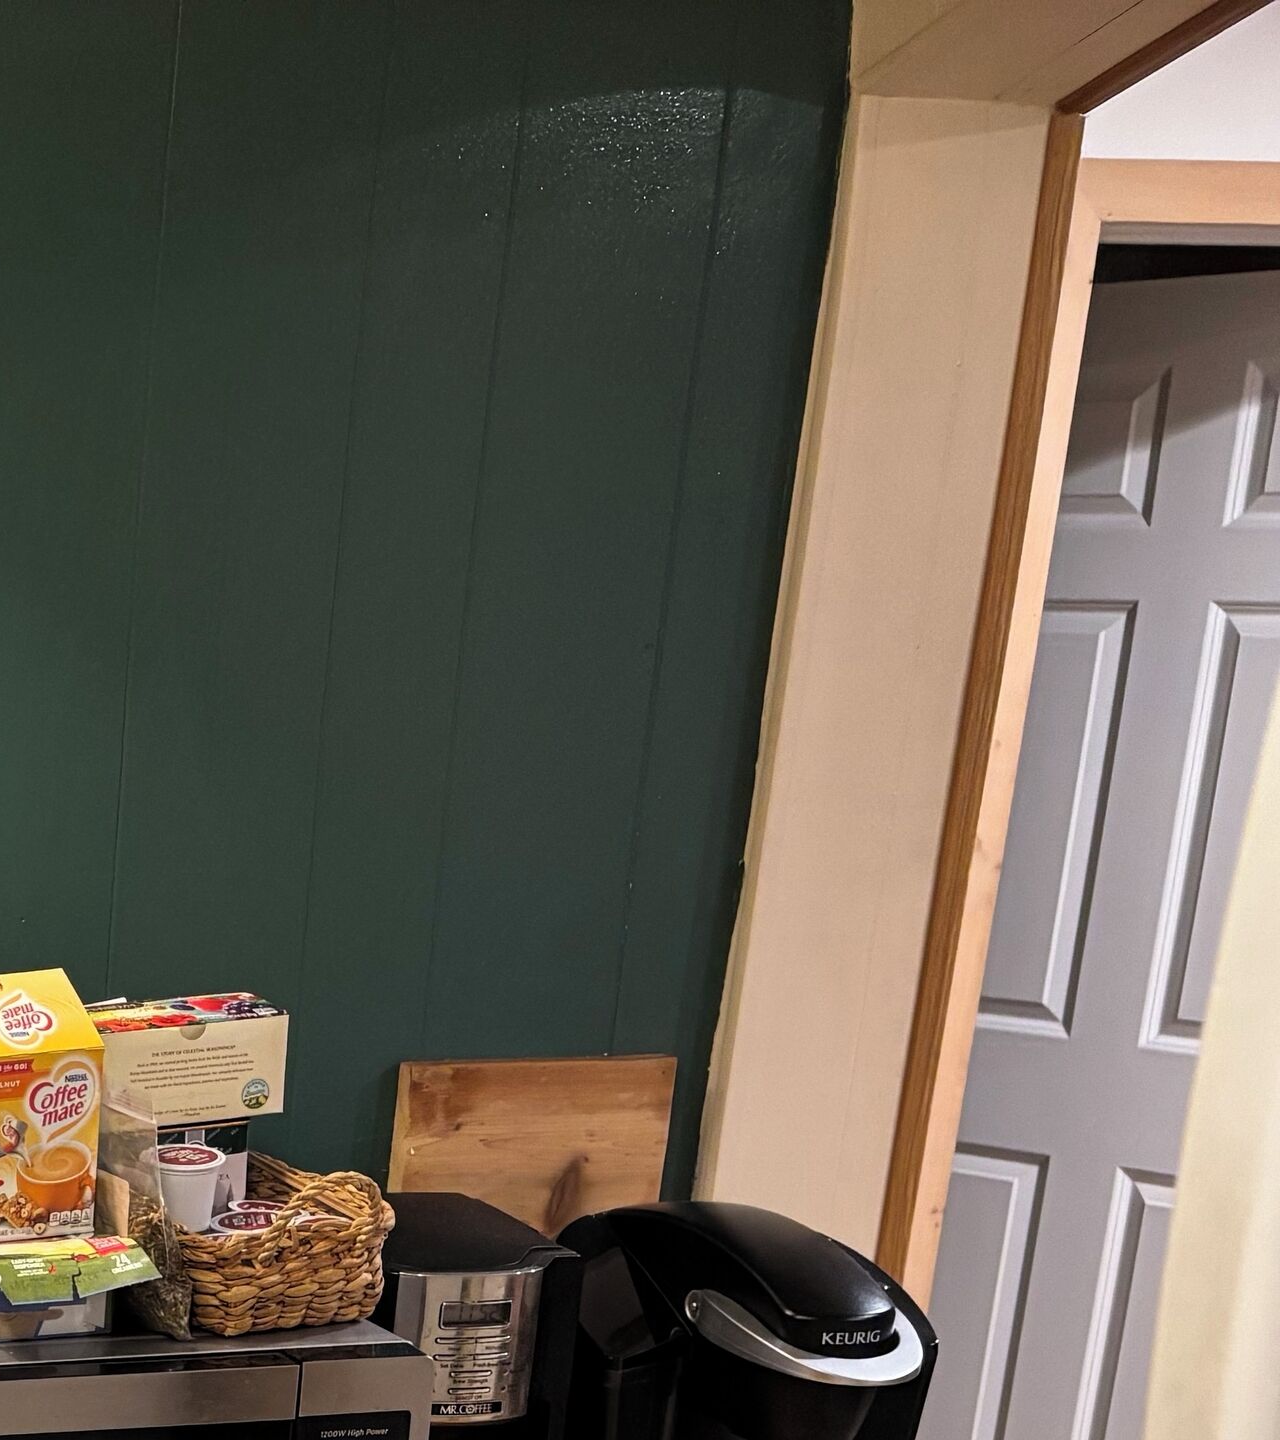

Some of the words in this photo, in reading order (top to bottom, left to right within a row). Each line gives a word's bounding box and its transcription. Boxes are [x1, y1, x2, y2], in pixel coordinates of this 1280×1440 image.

[29, 1081, 88, 1114] Coffee
[42, 1101, 85, 1127] mate
[111, 1254, 132, 1268] 24
[822, 1330, 881, 1345] KEURIG
